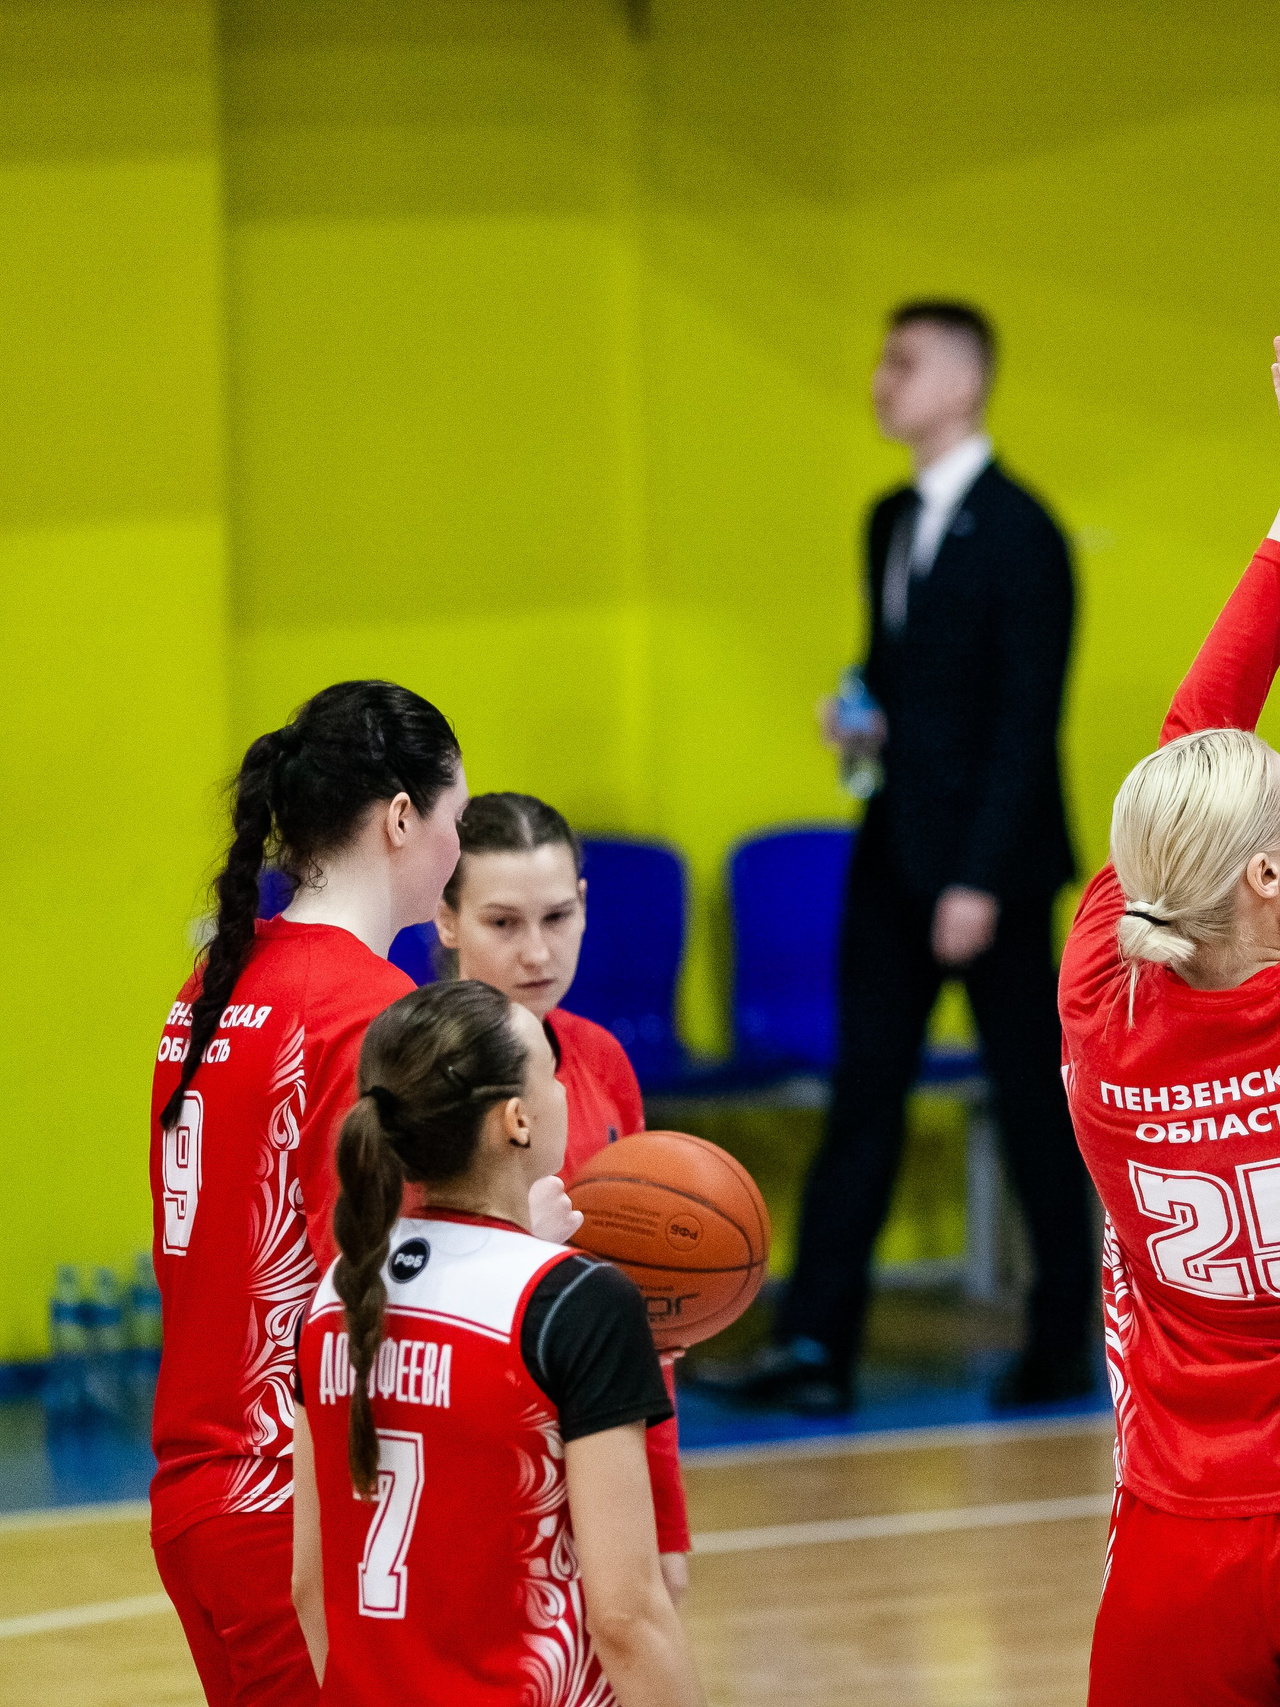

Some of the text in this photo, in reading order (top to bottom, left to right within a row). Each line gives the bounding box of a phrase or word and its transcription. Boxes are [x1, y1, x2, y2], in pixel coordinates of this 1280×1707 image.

[162, 1089, 204, 1257] 9
[393, 1252, 424, 1269] РФБ
[319, 1331, 453, 1409] ДОФЕЕВА
[353, 1427, 425, 1620] 7
